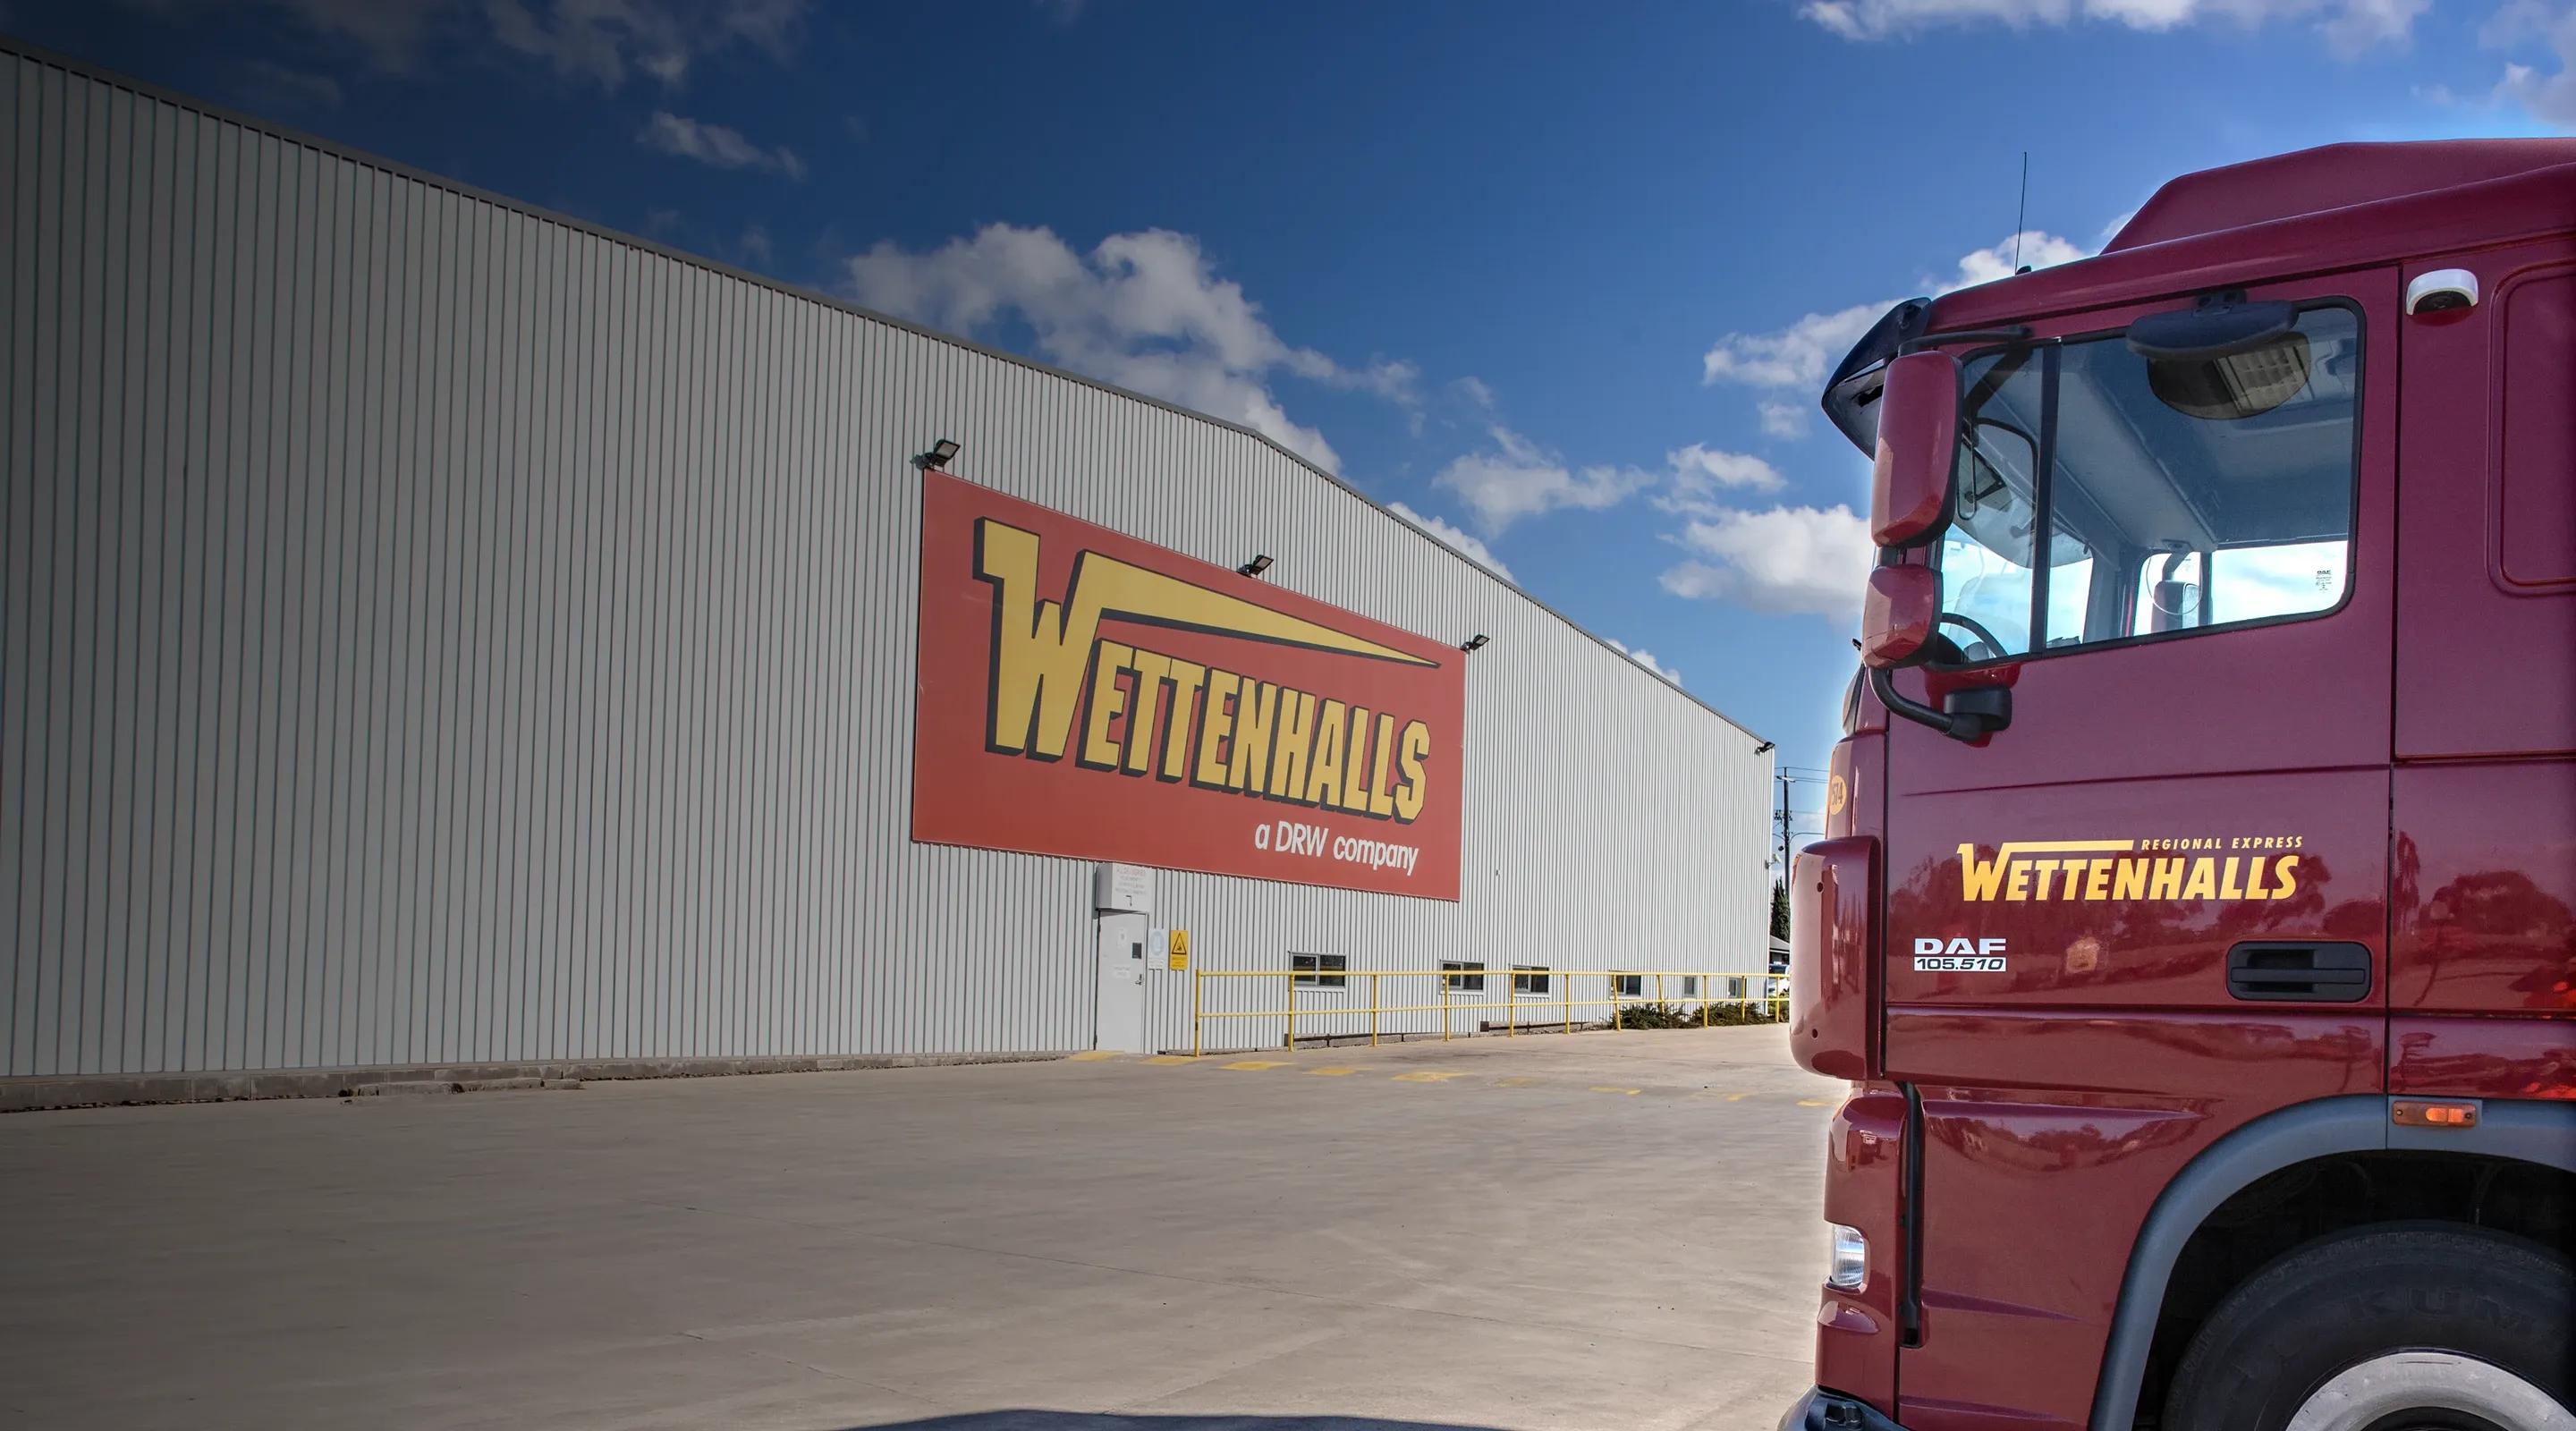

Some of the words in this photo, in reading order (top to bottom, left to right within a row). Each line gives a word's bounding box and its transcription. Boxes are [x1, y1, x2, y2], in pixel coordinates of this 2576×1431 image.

[973, 516, 1441, 824] WETTENHALLS
[1255, 824, 1271, 850] a
[1275, 820, 1329, 857] DRW
[1333, 835, 1419, 876] company
[2141, 837, 2222, 851] REGIONAL
[2232, 835, 2303, 849] EXPRESS
[1957, 839, 2300, 902] WETTENHALLS
[1914, 937, 2006, 955] DAF
[1917, 958, 2004, 970] 105.510
